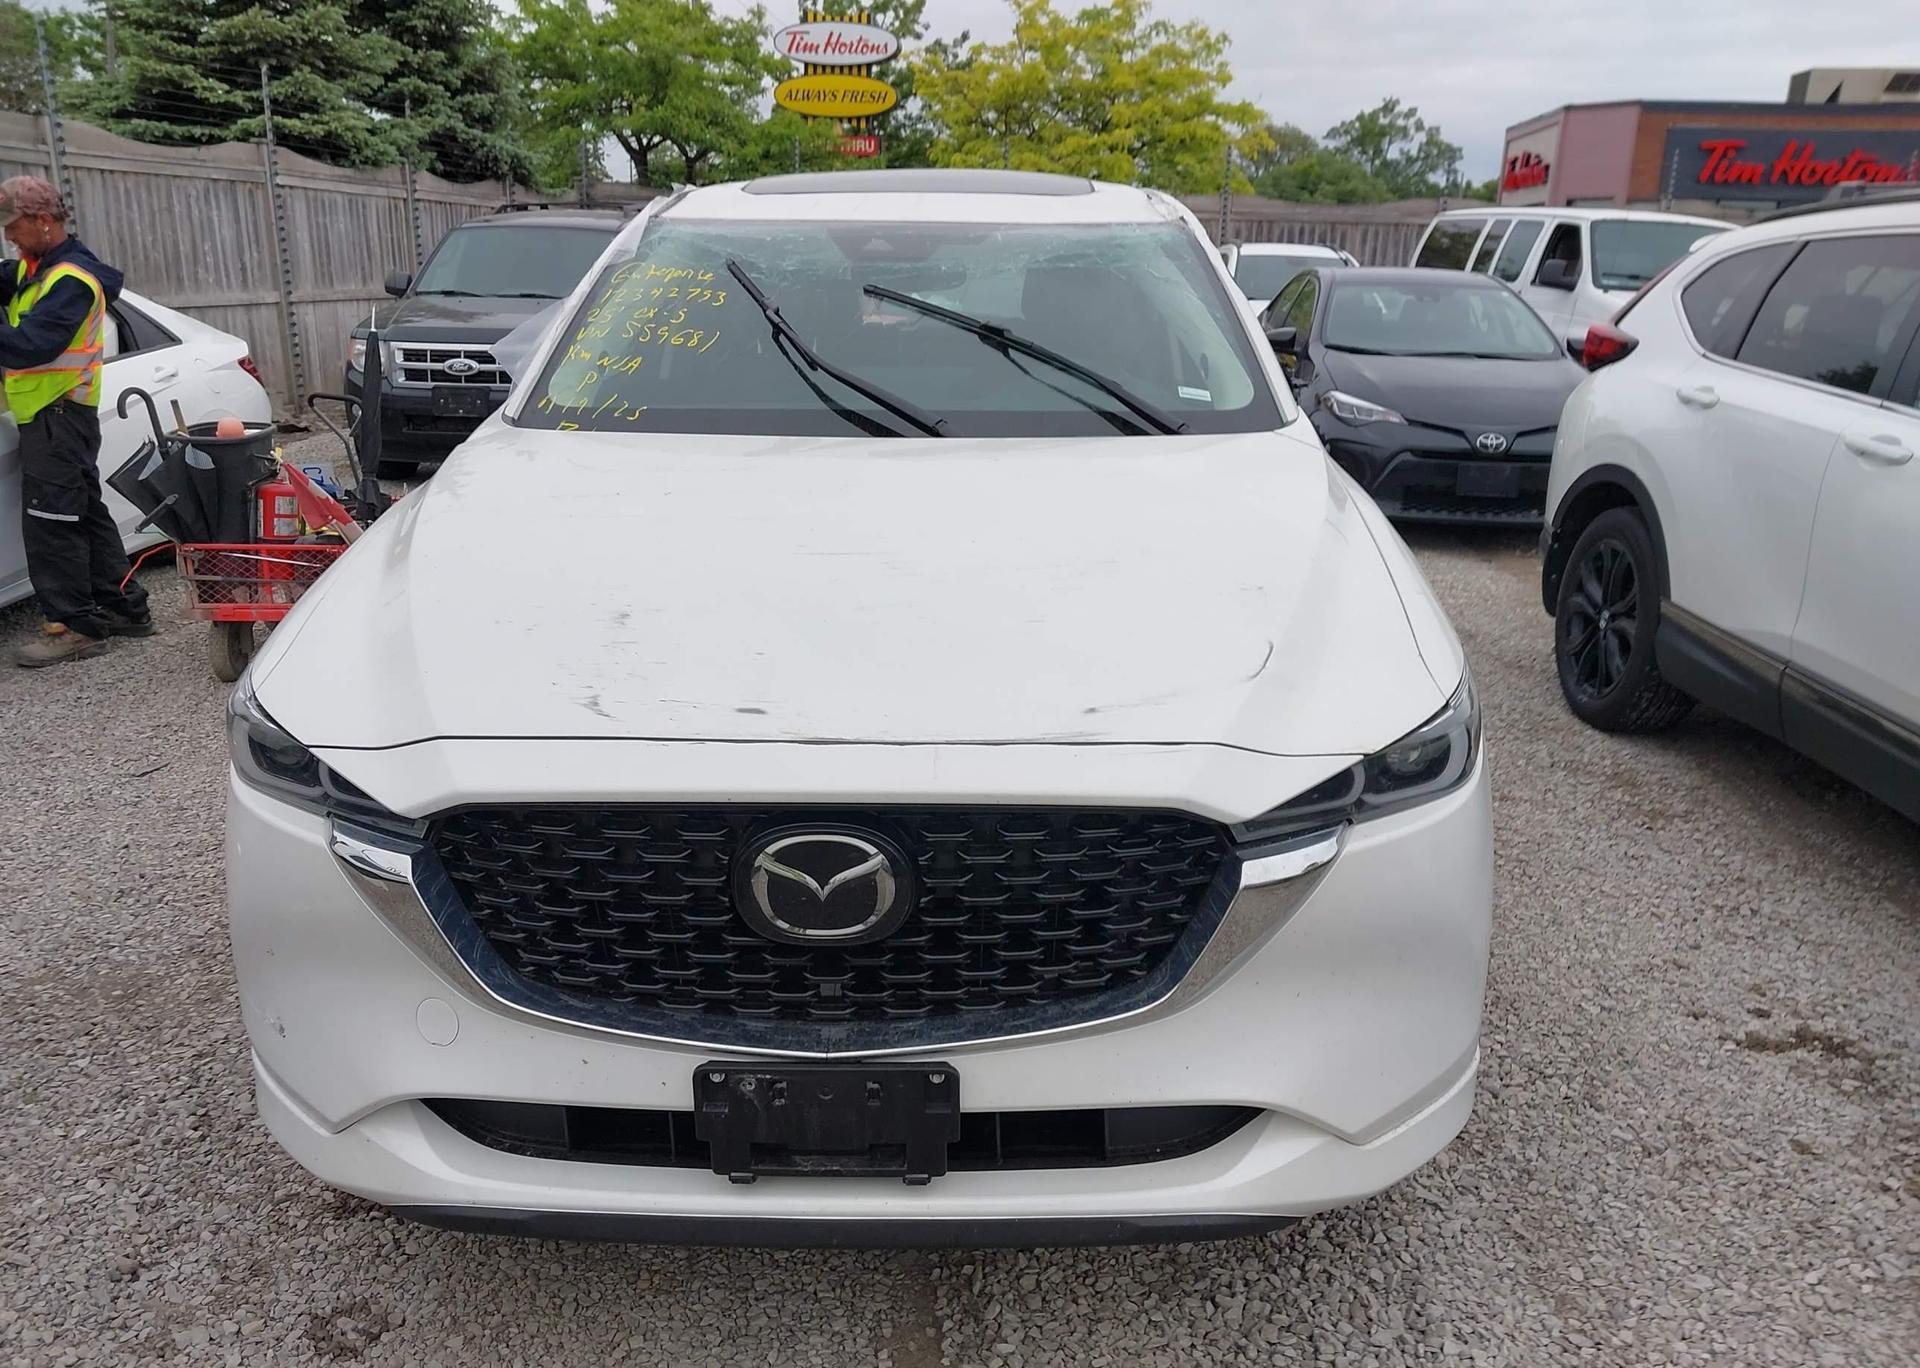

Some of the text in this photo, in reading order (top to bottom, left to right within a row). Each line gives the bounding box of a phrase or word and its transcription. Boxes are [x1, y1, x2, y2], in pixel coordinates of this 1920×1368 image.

[786, 30, 889, 56] Tim Hortons
[783, 88, 889, 105] ALWAYS FRESH
[1698, 138, 1764, 186] Tim
